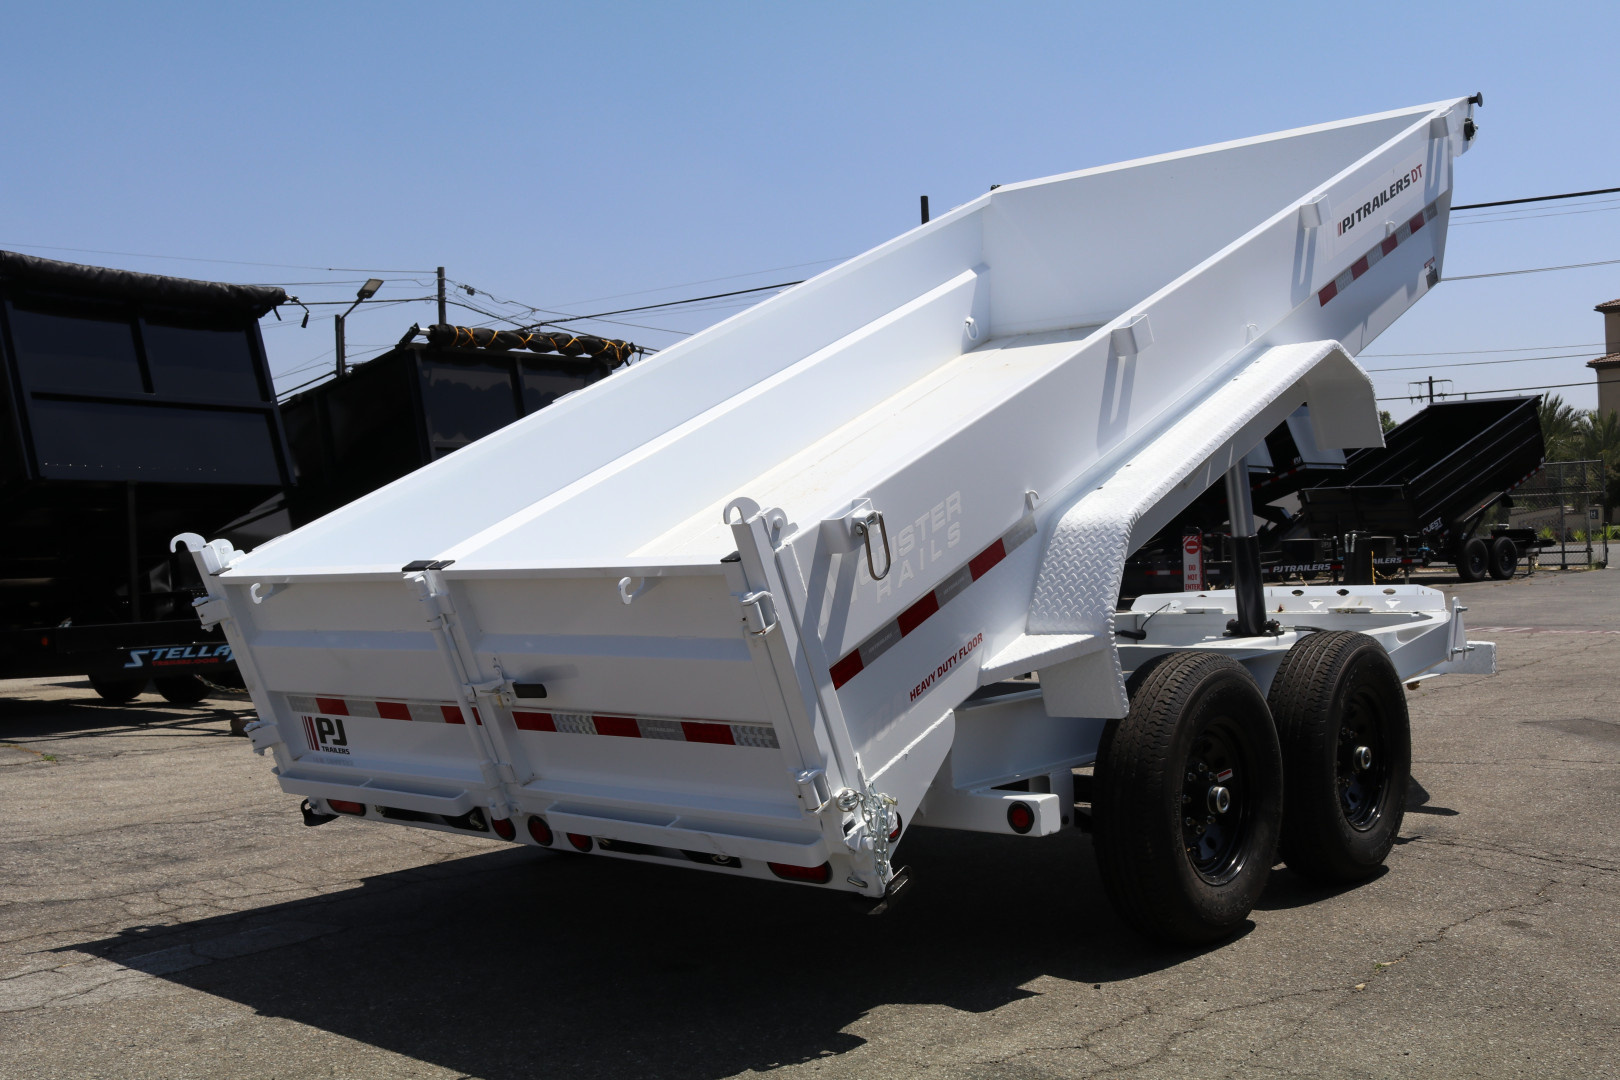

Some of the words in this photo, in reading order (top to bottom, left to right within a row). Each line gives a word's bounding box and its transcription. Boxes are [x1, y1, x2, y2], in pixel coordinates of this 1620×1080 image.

[1342, 213, 1355, 234] PJ
[1355, 174, 1411, 222] TRAILERS
[1410, 164, 1423, 183] DT
[876, 521, 961, 604] RAILS
[1272, 565, 1284, 573] PJ
[1284, 563, 1331, 572] TRAILERS
[1373, 557, 1402, 565] AILERS
[909, 670, 936, 702] HEAVY
[937, 652, 958, 678] DUTY
[958, 632, 983, 660] FLOOR
[315, 716, 348, 747] PJ
[321, 745, 351, 755] TRAILERS
